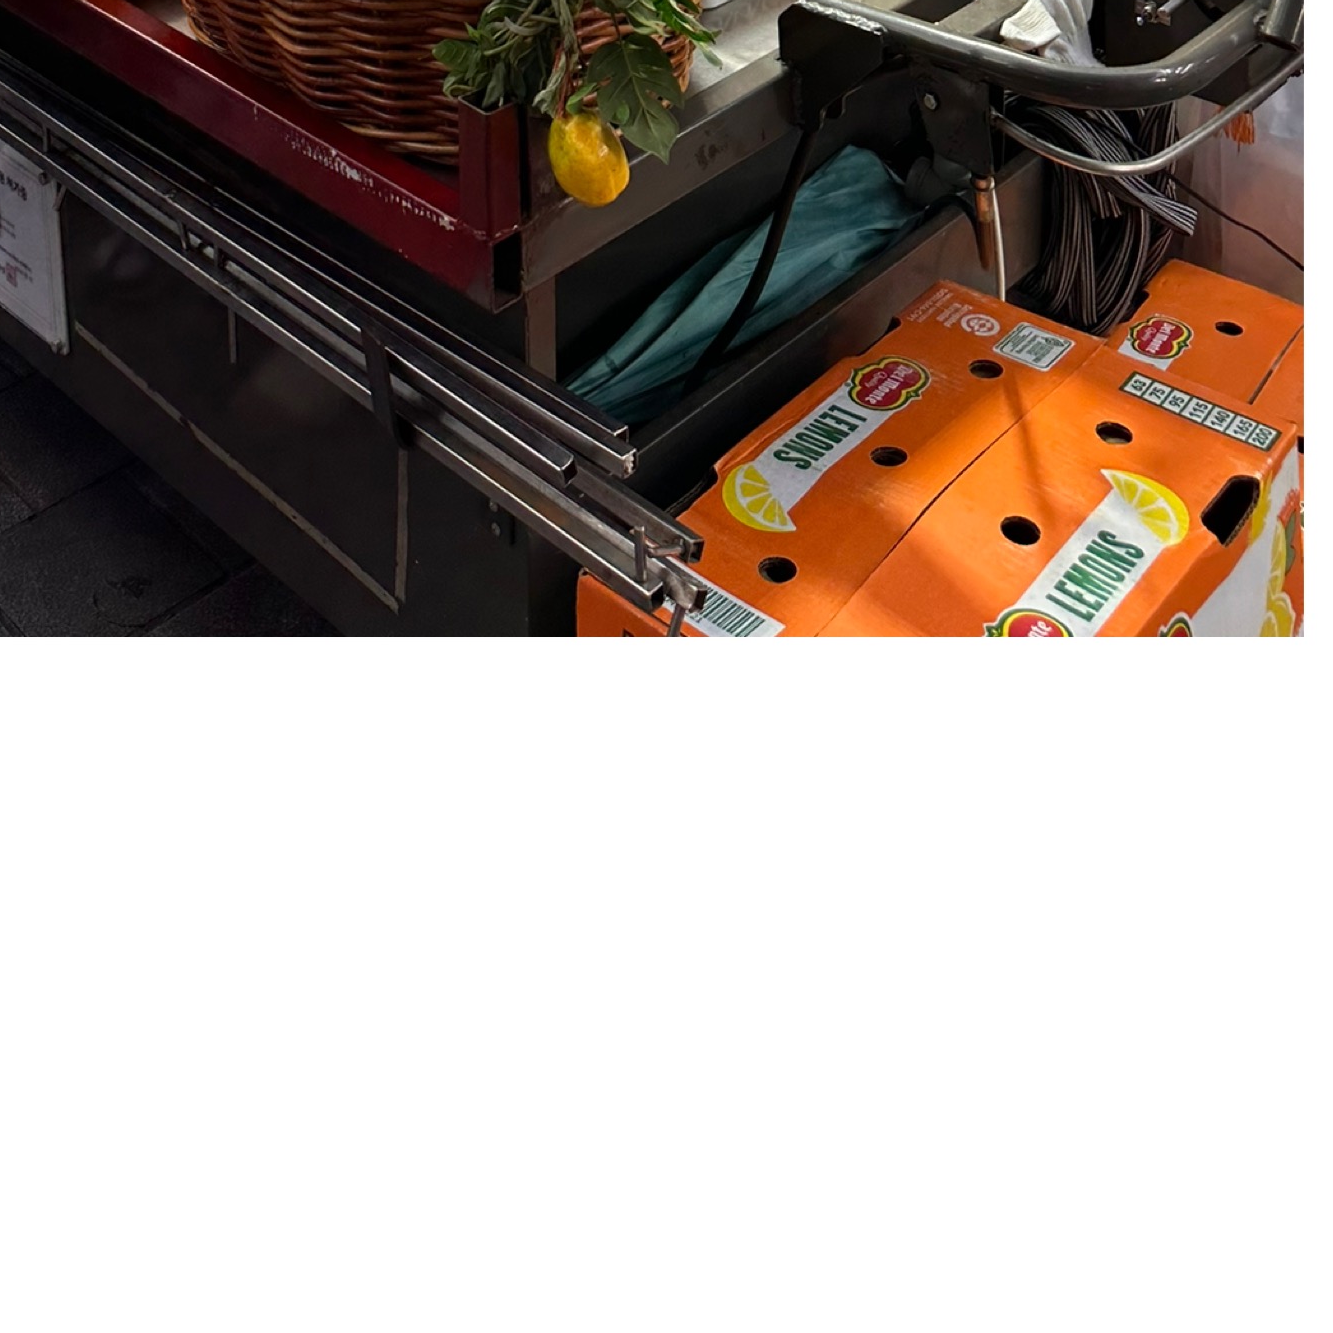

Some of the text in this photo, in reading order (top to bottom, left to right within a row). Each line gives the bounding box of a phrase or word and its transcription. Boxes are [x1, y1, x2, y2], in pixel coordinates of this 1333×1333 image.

[864, 364, 913, 405] Del Monte
[772, 404, 868, 470] LEMONS
[1149, 387, 1166, 401] 75
[1168, 395, 1185, 408] 95
[1188, 401, 1209, 419] 115
[1210, 410, 1231, 428] 140
[1233, 419, 1254, 436] 165
[1251, 427, 1273, 446] 200
[1045, 529, 1145, 623] LEMONS
[1027, 620, 1053, 638] nte
